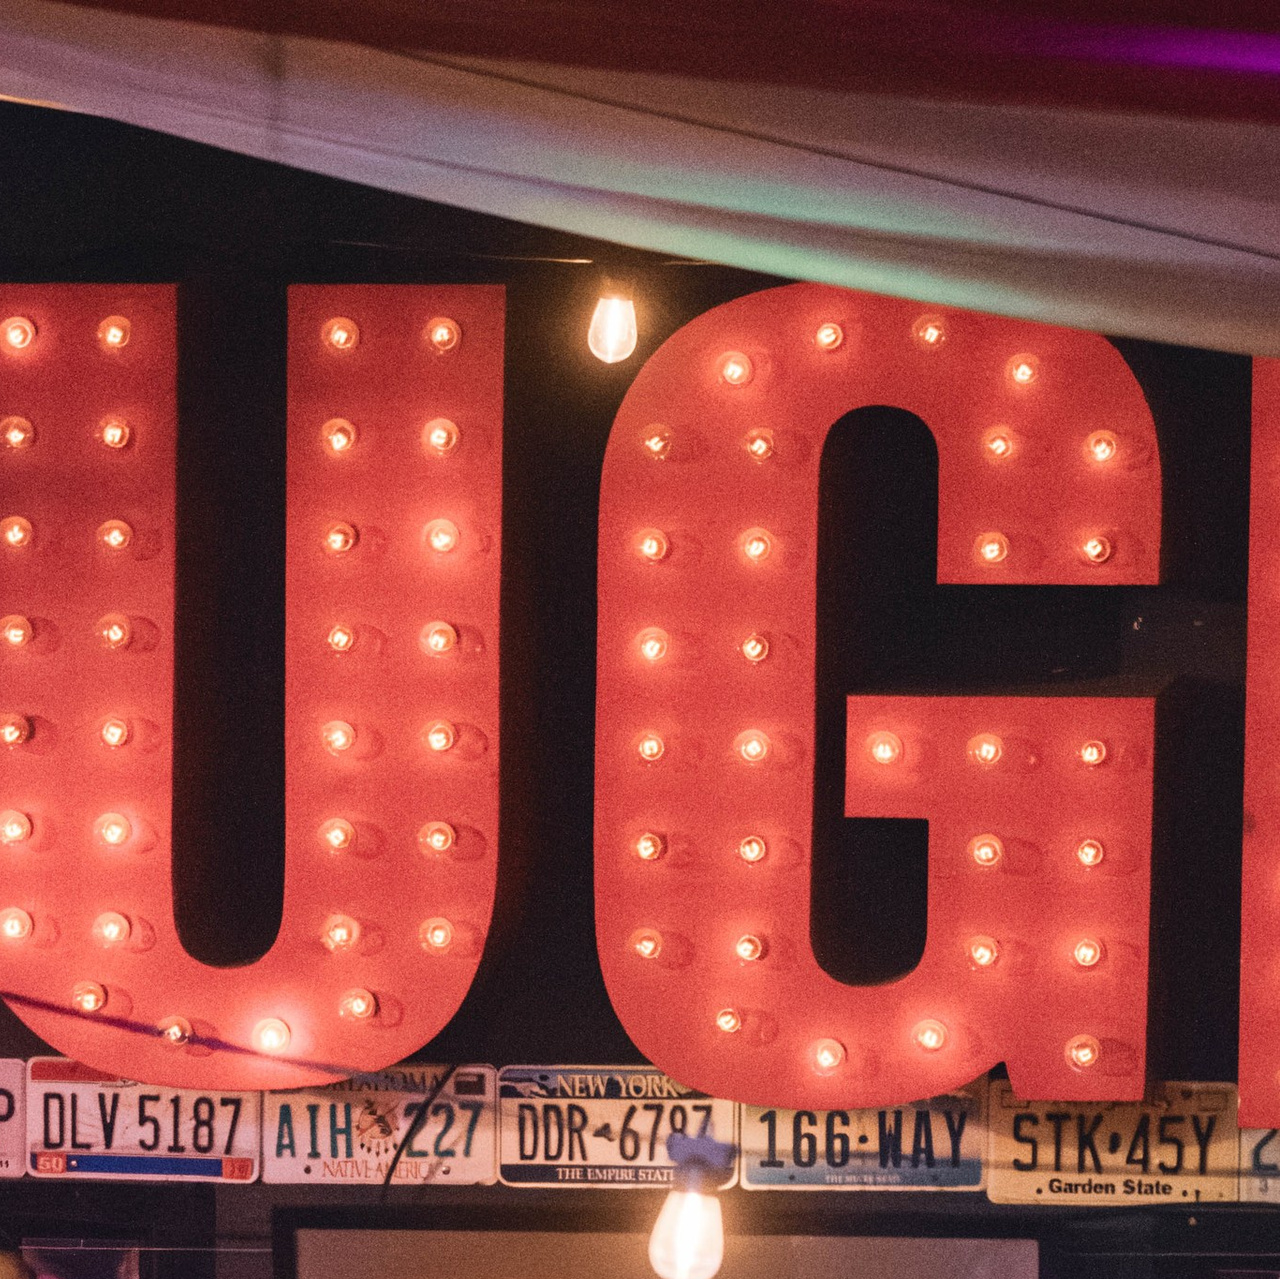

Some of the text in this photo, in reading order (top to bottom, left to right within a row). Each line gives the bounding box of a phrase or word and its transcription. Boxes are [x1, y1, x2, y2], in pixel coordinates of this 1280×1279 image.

[557, 1074, 678, 1098] NEW YORK
[43, 1092, 242, 1155] DLV 5187
[276, 1100, 484, 1159] AIH 227
[519, 1104, 587, 1161] DDR
[557, 1168, 584, 1180] THE
[588, 1168, 635, 1181] EMPIRE
[1048, 1178, 1173, 1196] Garden State
